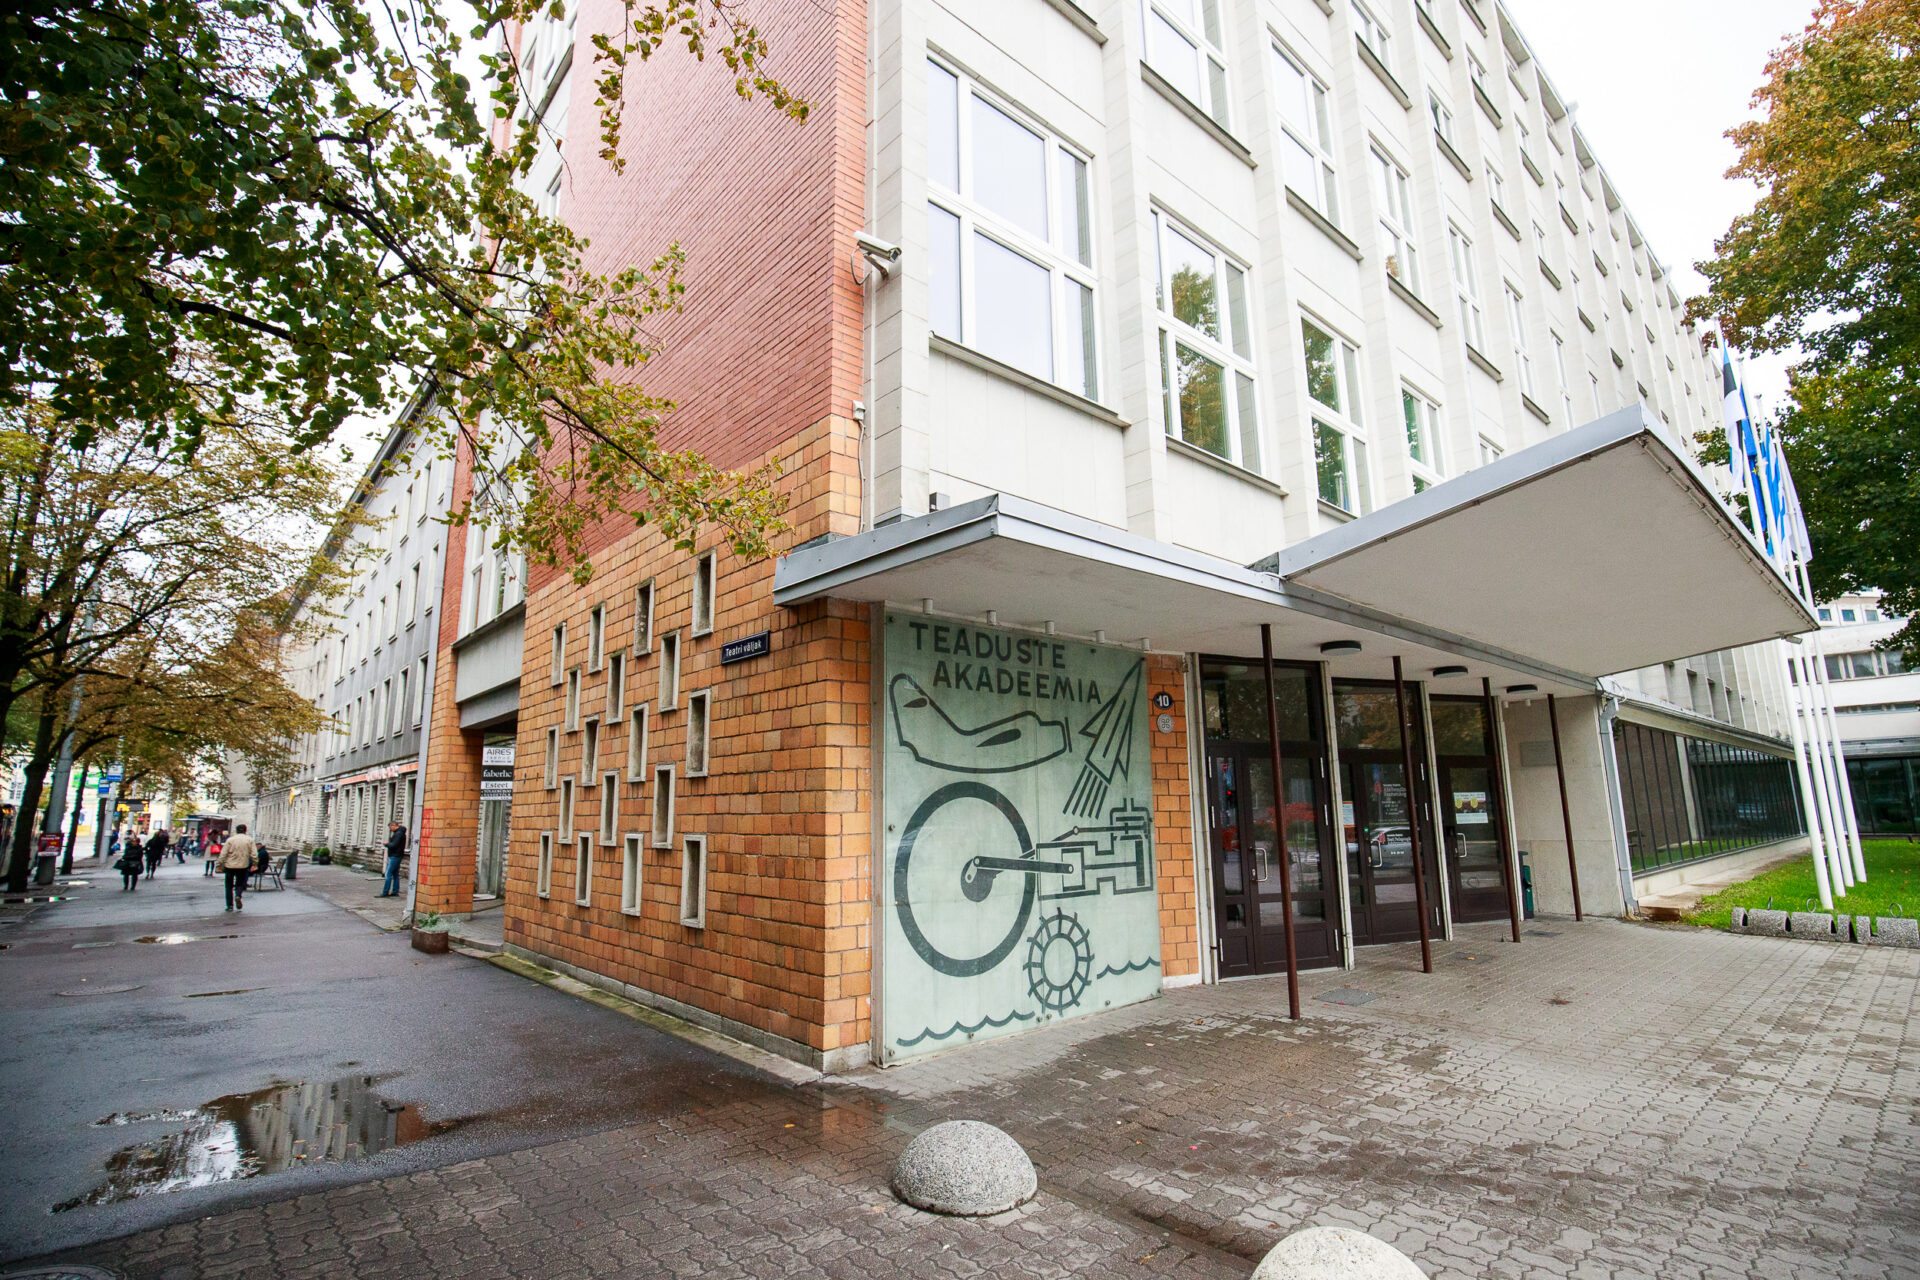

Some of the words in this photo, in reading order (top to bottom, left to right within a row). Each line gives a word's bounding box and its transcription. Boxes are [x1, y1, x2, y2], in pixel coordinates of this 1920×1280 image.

[725, 645, 743, 656] Teatri
[743, 640, 761, 652] väljak
[909, 621, 1066, 670] TEADUSTE
[932, 660, 1102, 705] AKADEEMIA
[1157, 694, 1170, 707] 10
[487, 748, 511, 756] AIRES
